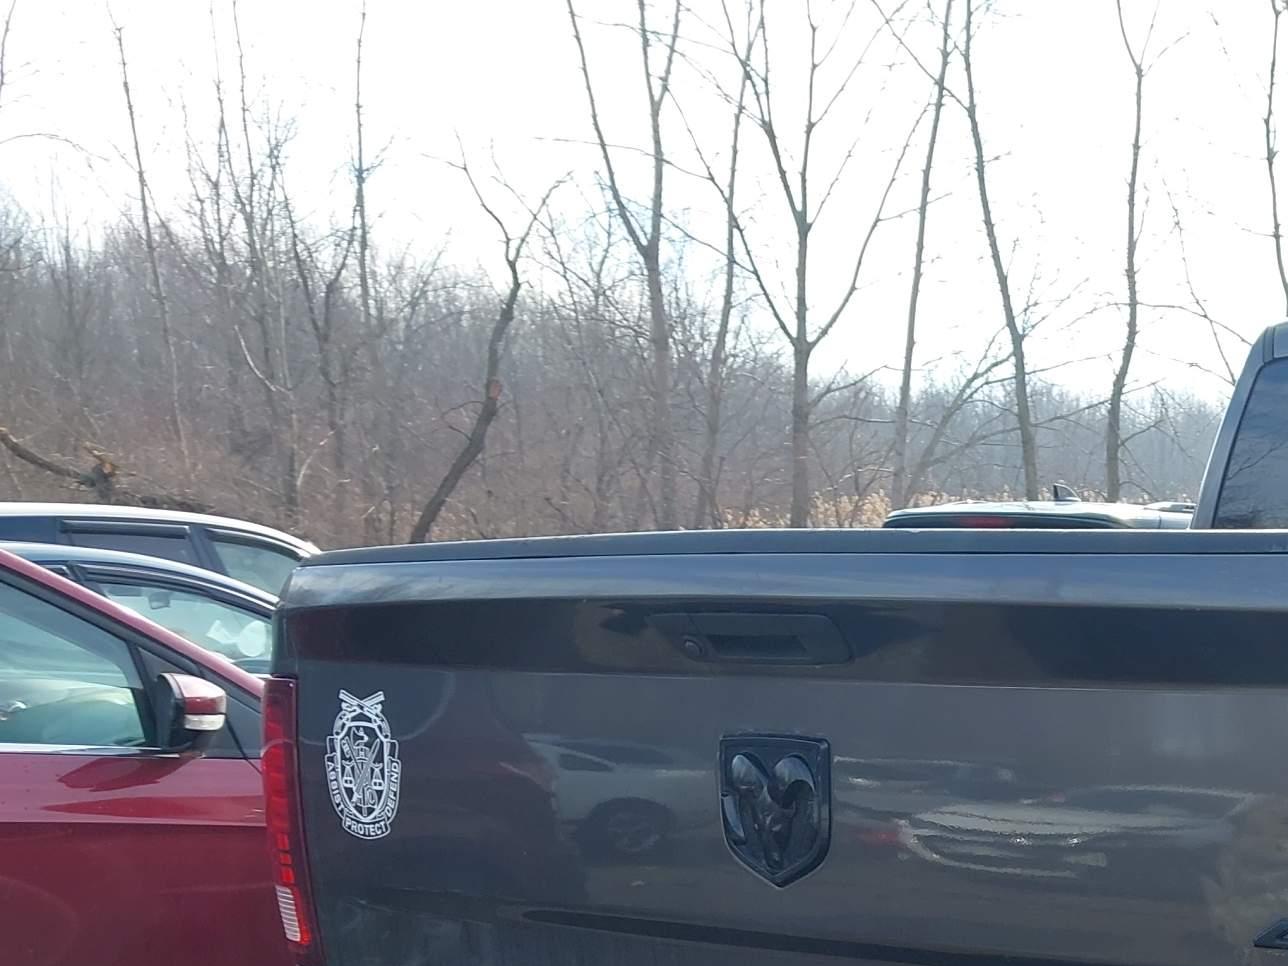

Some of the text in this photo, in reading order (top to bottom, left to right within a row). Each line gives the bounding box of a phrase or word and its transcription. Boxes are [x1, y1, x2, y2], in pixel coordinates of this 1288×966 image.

[327, 761, 345, 812] ASSIST
[385, 761, 399, 818] DEFEND
[344, 818, 387, 836] PROTECT
